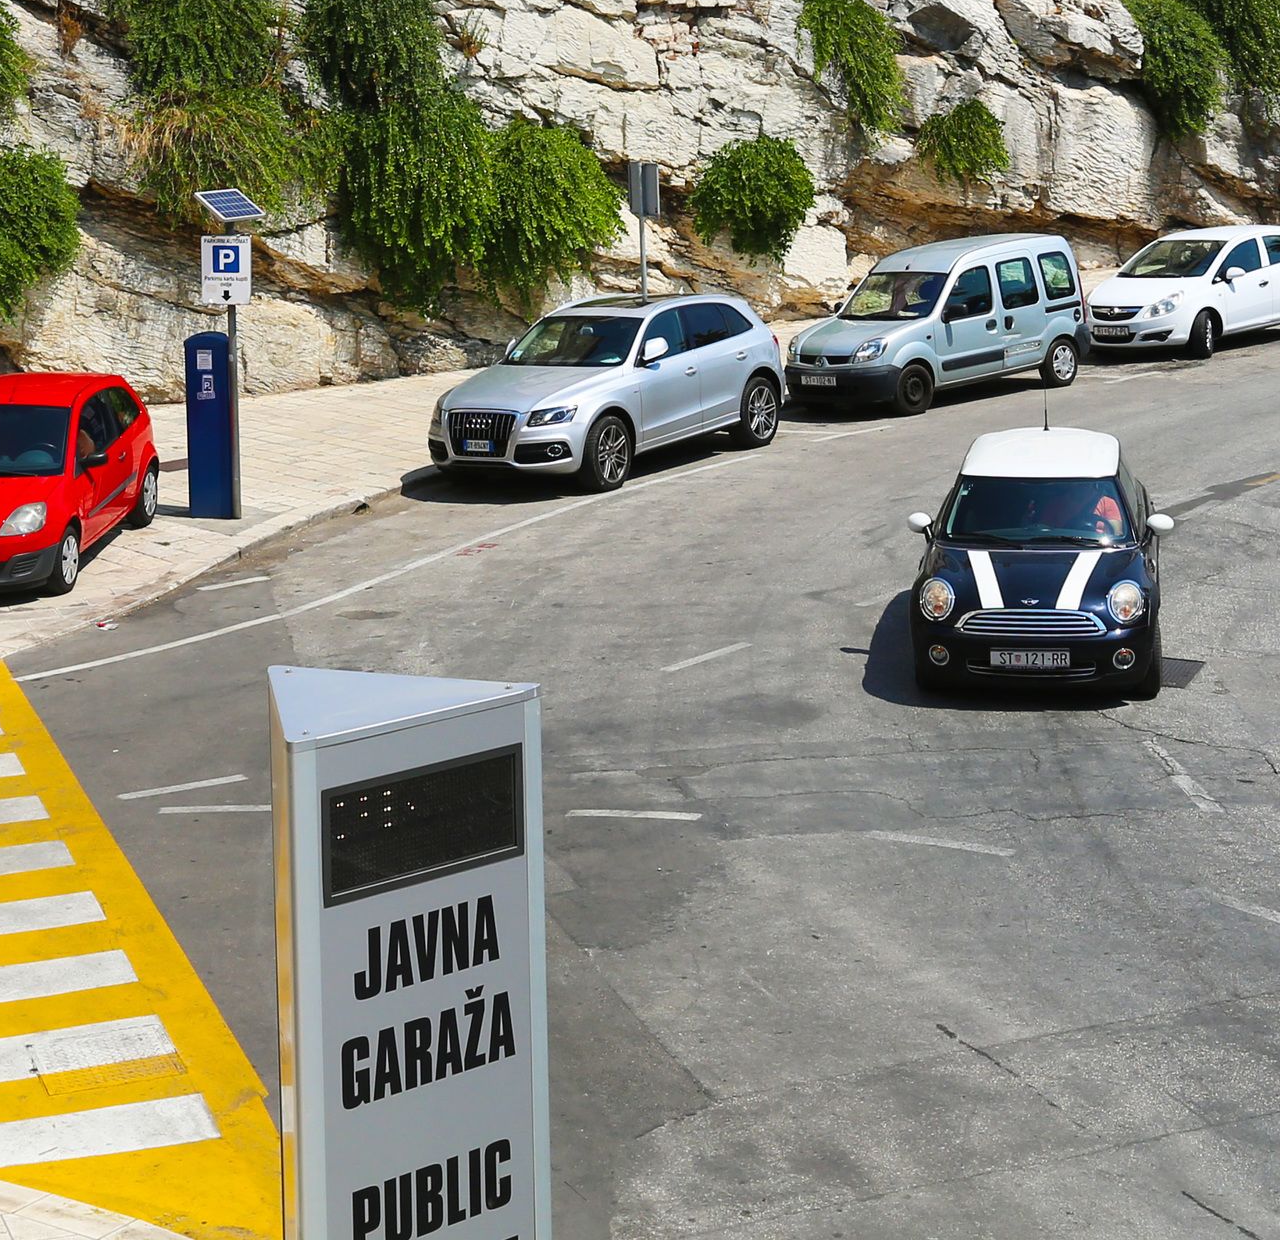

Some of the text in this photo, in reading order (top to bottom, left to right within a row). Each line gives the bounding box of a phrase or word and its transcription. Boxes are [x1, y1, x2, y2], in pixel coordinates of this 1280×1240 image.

[219, 249, 236, 270] P
[1000, 652, 1068, 666] ST 121-RR
[353, 894, 500, 1001] JAVNA
[341, 985, 517, 1110] GARAŽA
[352, 1138, 513, 1240] PUBLIC
